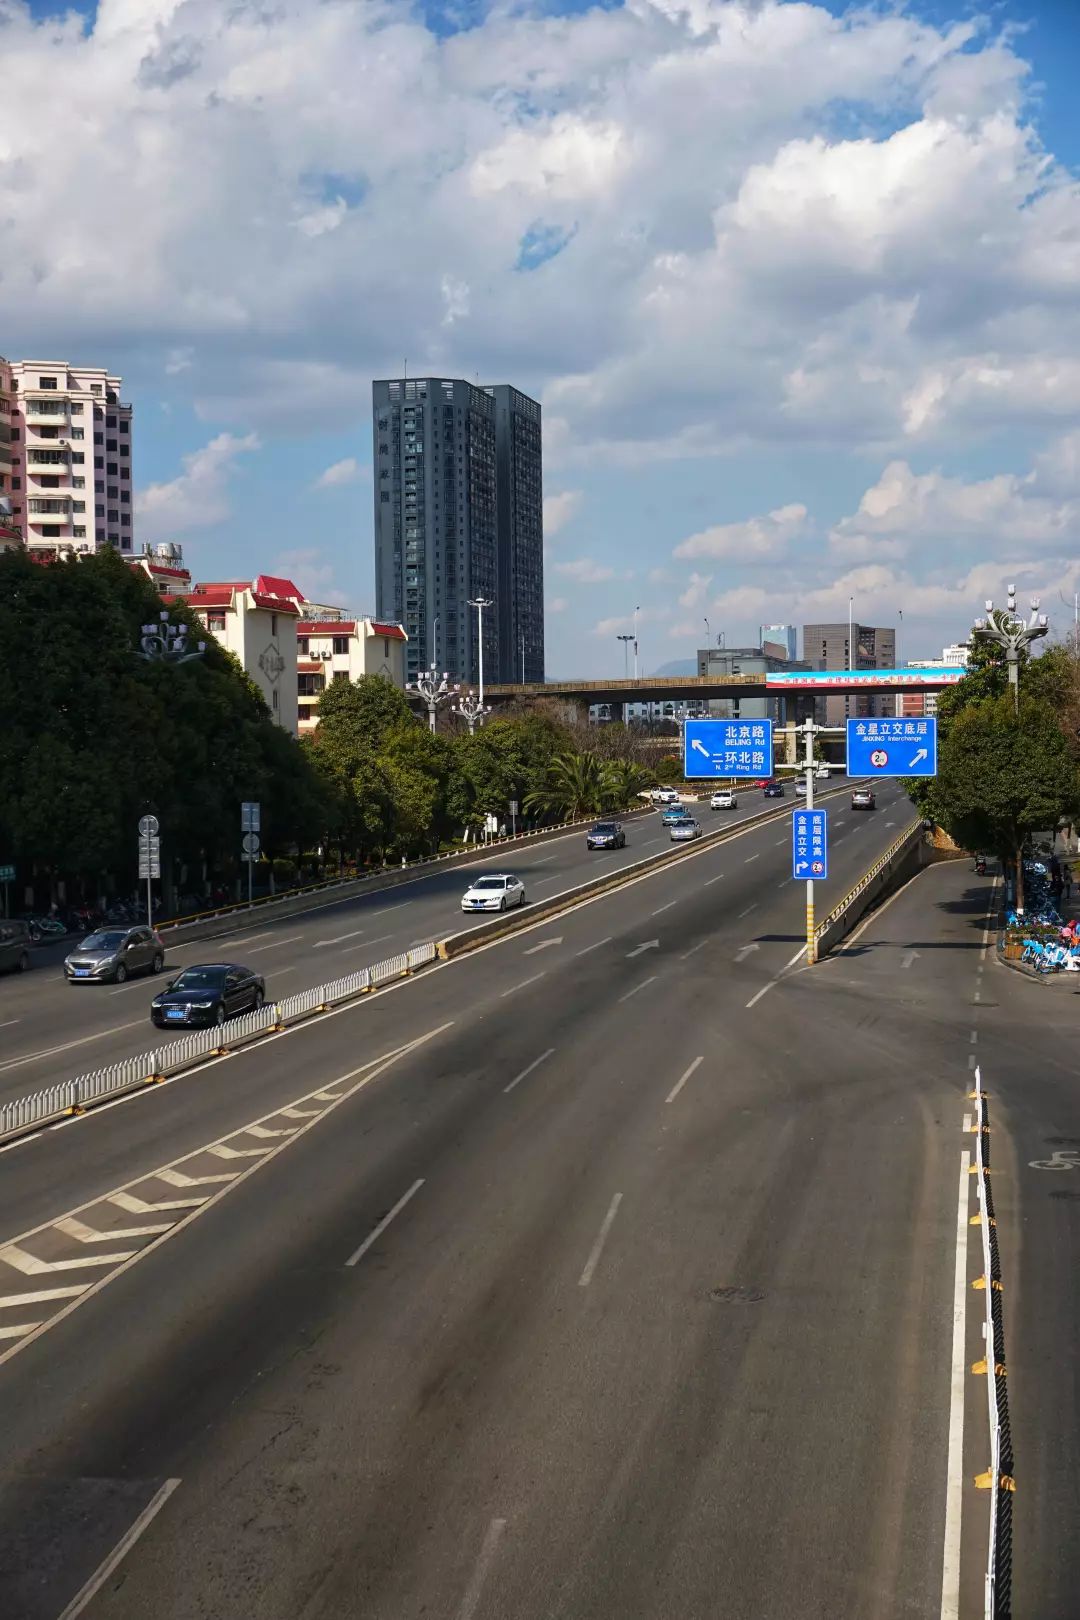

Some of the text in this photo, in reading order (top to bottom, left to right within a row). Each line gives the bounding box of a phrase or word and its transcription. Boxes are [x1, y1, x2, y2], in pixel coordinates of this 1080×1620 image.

[725, 726, 764, 738] 北京路
[856, 723, 927, 734] 金星立交底层
[712, 752, 764, 763] 二环北路
[798, 815, 806, 856] 金星立交
[812, 815, 821, 856] 底层限高
